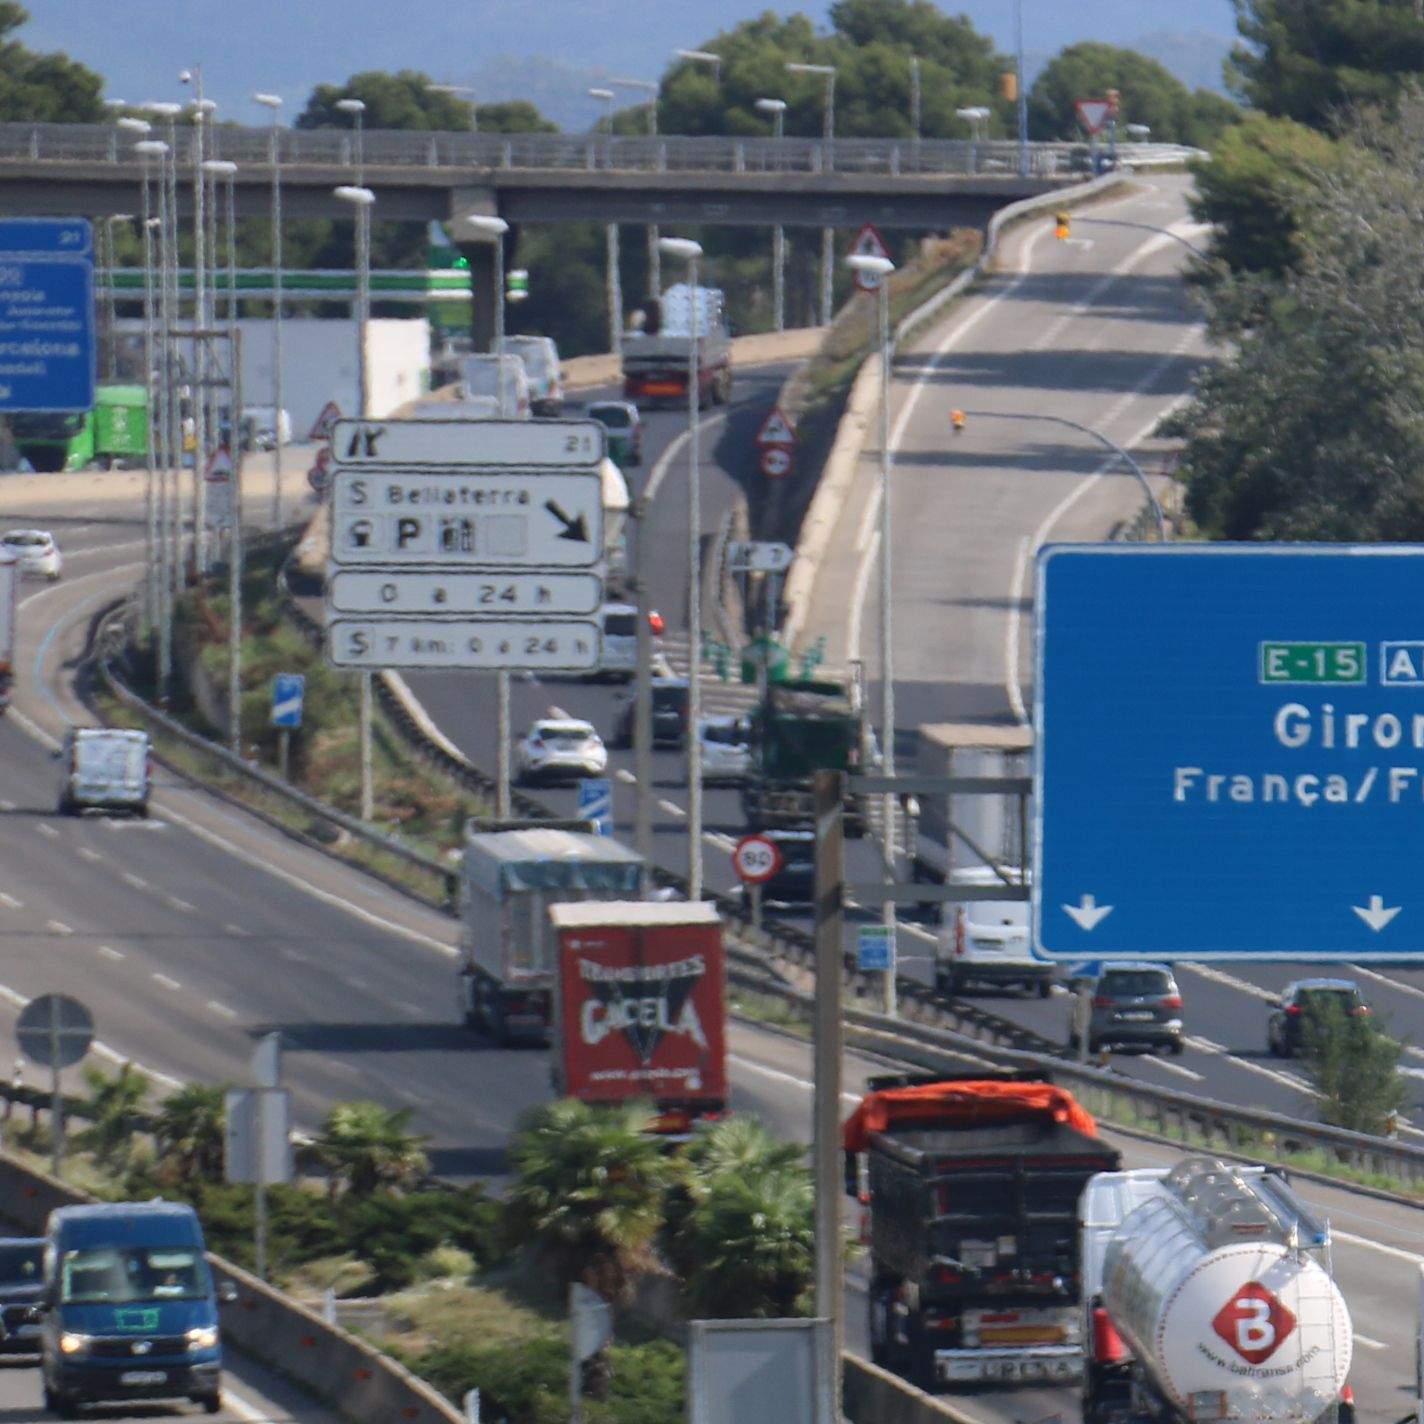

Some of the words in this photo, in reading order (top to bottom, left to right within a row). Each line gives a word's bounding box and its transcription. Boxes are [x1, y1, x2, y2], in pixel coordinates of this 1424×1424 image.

[387, 485, 531, 505] Bellaterra
[396, 517, 421, 549] P
[479, 584, 517, 604] 24
[1266, 648, 1360, 679] E-15
[743, 851, 771, 868] 80
